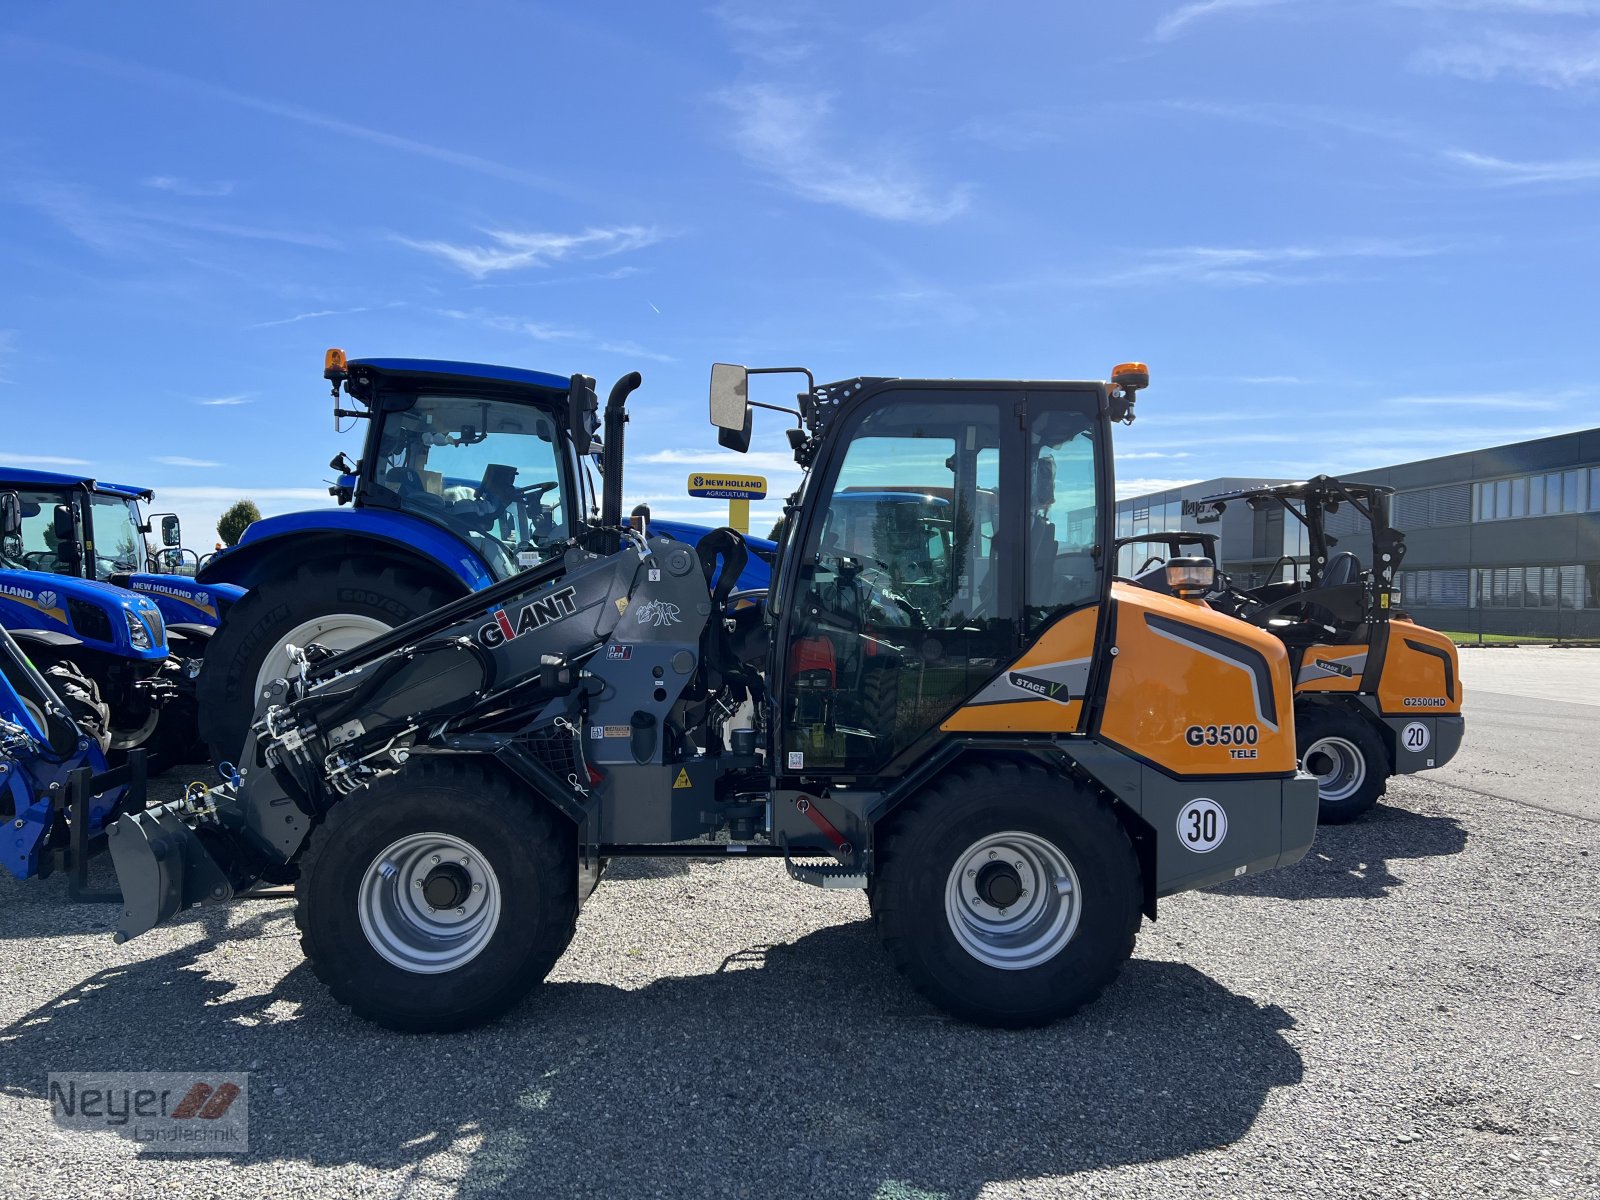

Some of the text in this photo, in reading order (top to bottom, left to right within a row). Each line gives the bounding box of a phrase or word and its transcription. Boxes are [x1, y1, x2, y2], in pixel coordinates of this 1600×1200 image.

[705, 479, 762, 488] NEW HOLLAND
[705, 490, 749, 498] AGRICULTURE
[132, 582, 192, 599] NEW HOLLAND
[1320, 662, 1339, 673] STAGE
[1016, 678, 1066, 696] STAGE V
[1403, 696, 1446, 707] G2500HD
[1185, 723, 1259, 747] G3500
[1407, 727, 1424, 747] 20
[1229, 749, 1257, 759] TELE
[1187, 808, 1217, 843] 30
